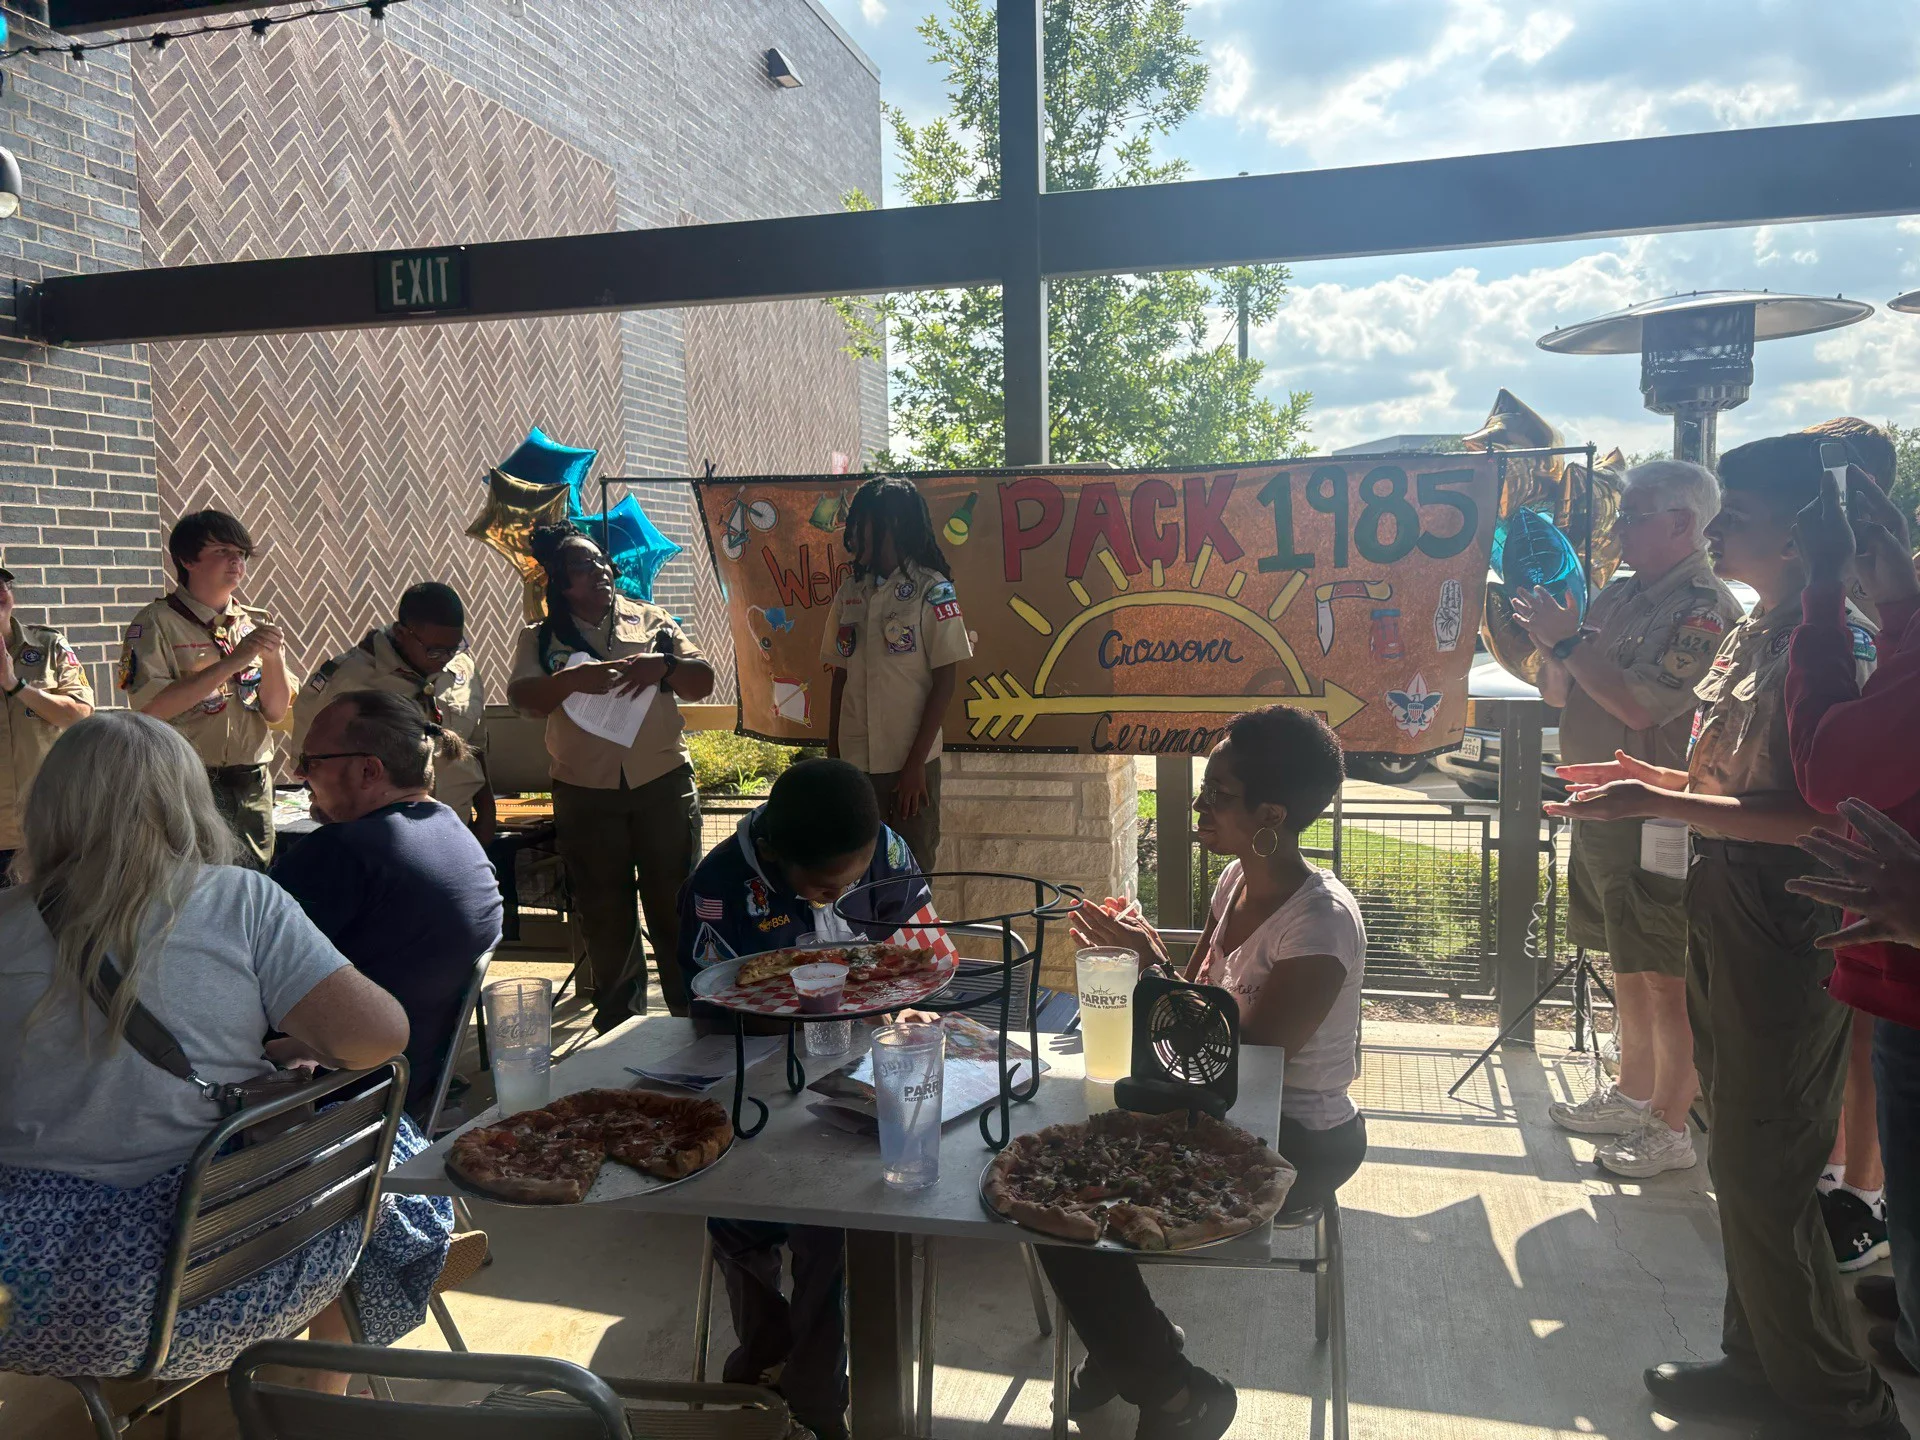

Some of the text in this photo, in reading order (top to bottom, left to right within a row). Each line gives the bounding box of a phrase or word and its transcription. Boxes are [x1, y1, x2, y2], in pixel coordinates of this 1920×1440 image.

[391, 257, 450, 306] EXIT
[997, 465, 1479, 582] PACK 1985
[1098, 629, 1244, 670] Crossover
[1090, 712, 1228, 753] Ceremon
[771, 914, 791, 929] BSA
[1081, 991, 1128, 1006] PARRY'S
